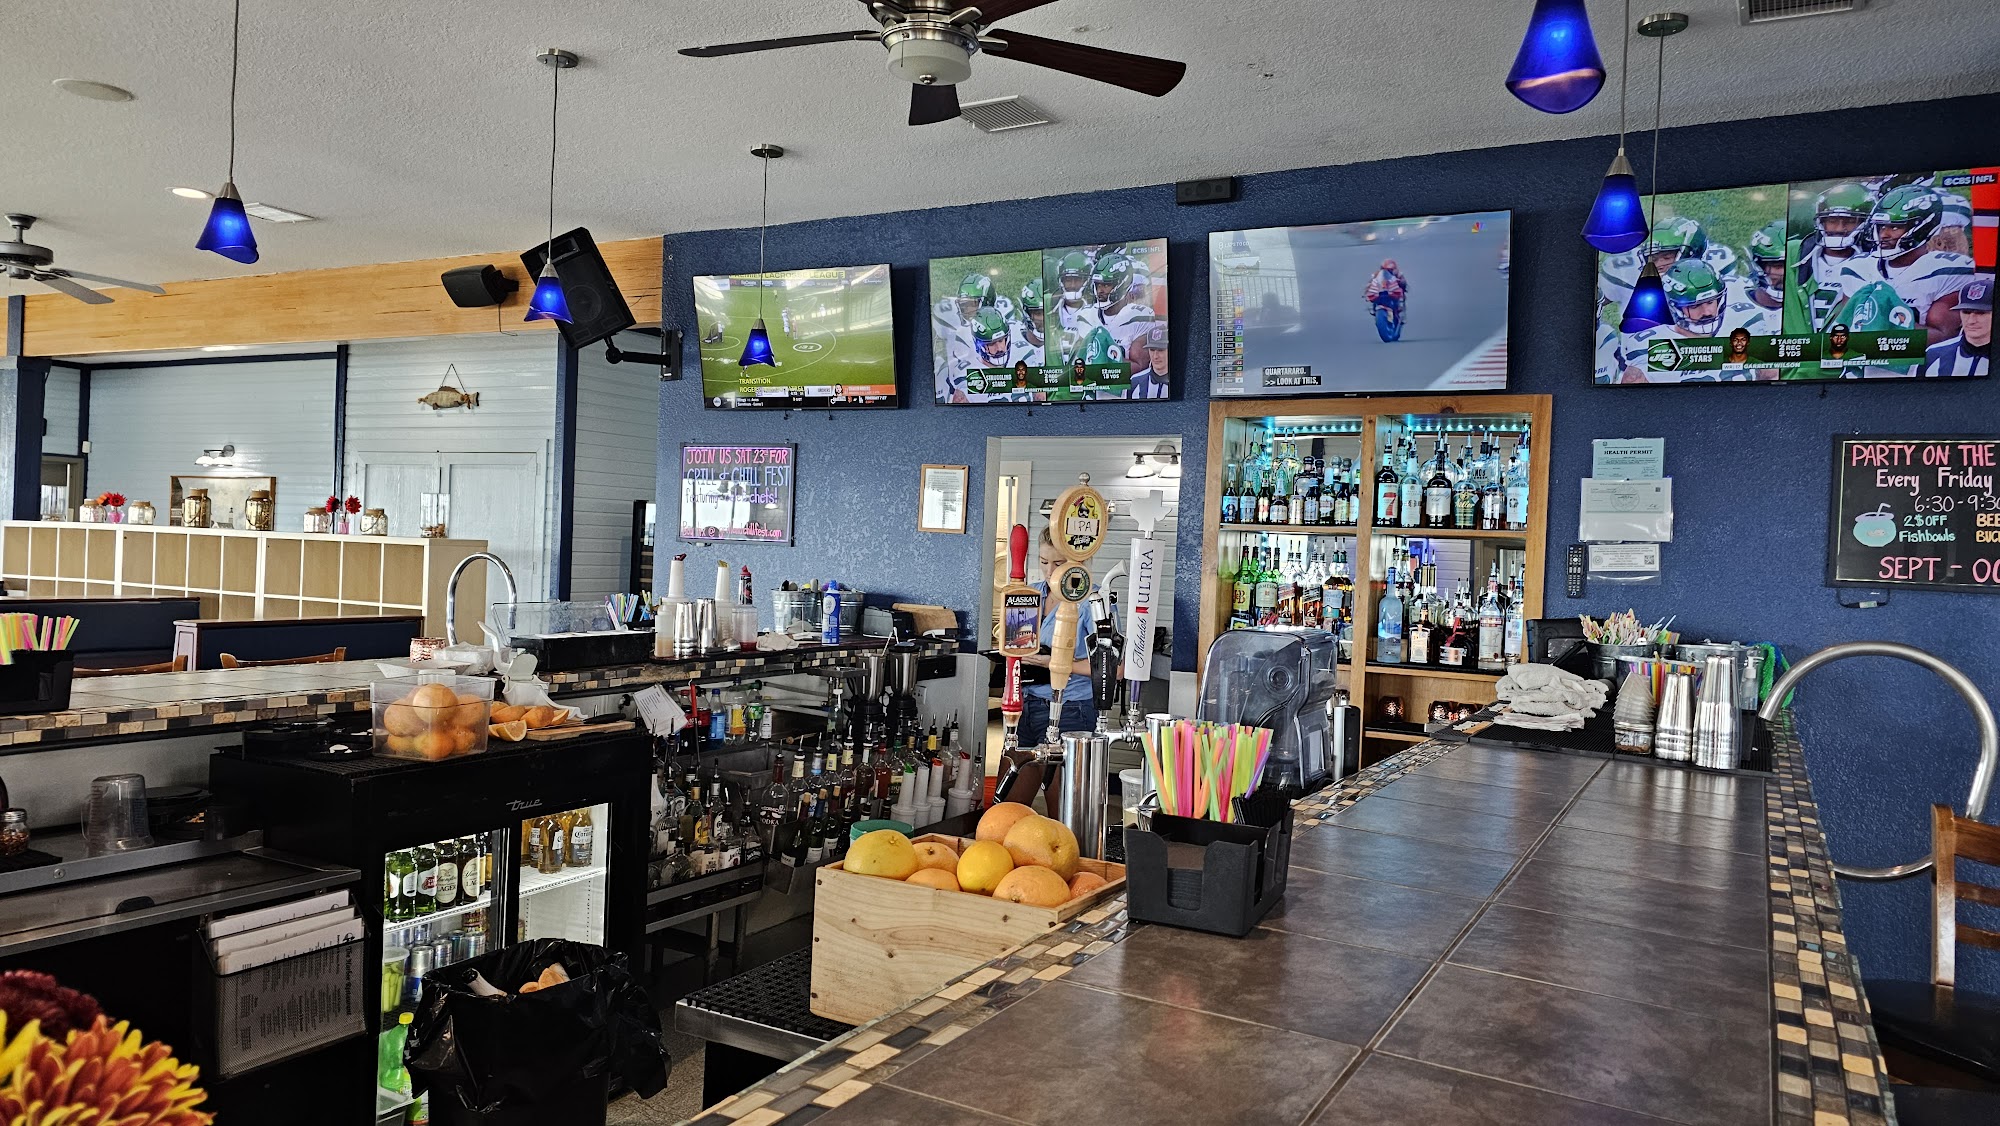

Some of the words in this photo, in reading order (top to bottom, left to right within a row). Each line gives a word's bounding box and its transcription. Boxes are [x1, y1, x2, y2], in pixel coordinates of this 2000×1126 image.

[1976, 175, 1995, 184] NFL
[1778, 338, 1811, 346] TARGETS
[1680, 345, 1724, 356] STRUGGLING
[1689, 355, 1713, 363] STARS
[1774, 361, 1801, 369] WILSON
[1277, 378, 1294, 387] LOOK
[1294, 378, 1302, 386] AT
[1303, 377, 1319, 386] THIS,
[687, 449, 716, 465] JOIN
[719, 449, 732, 464] US
[735, 449, 752, 465] SAT
[769, 449, 788, 465] FOR
[1851, 444, 1917, 467] PARTY
[1922, 444, 1950, 466] ON
[1957, 444, 1997, 467] THE
[731, 466, 761, 487] CHILL
[764, 465, 790, 487] FEST
[1876, 468, 1920, 497] Every
[1937, 466, 1993, 496] Friday
[750, 487, 778, 504] chefs!
[1383, 492, 1397, 516] 7
[1073, 520, 1093, 533] IPA
[1899, 528, 1956, 543] Fishbowls
[1138, 549, 1154, 604] ULTRA
[1878, 556, 1942, 582] SEPT
[1006, 596, 1039, 606] ALASKAN
[1132, 616, 1147, 669] Michelob
[1012, 659, 1021, 703] AMBER
[506, 799, 542, 811] true
